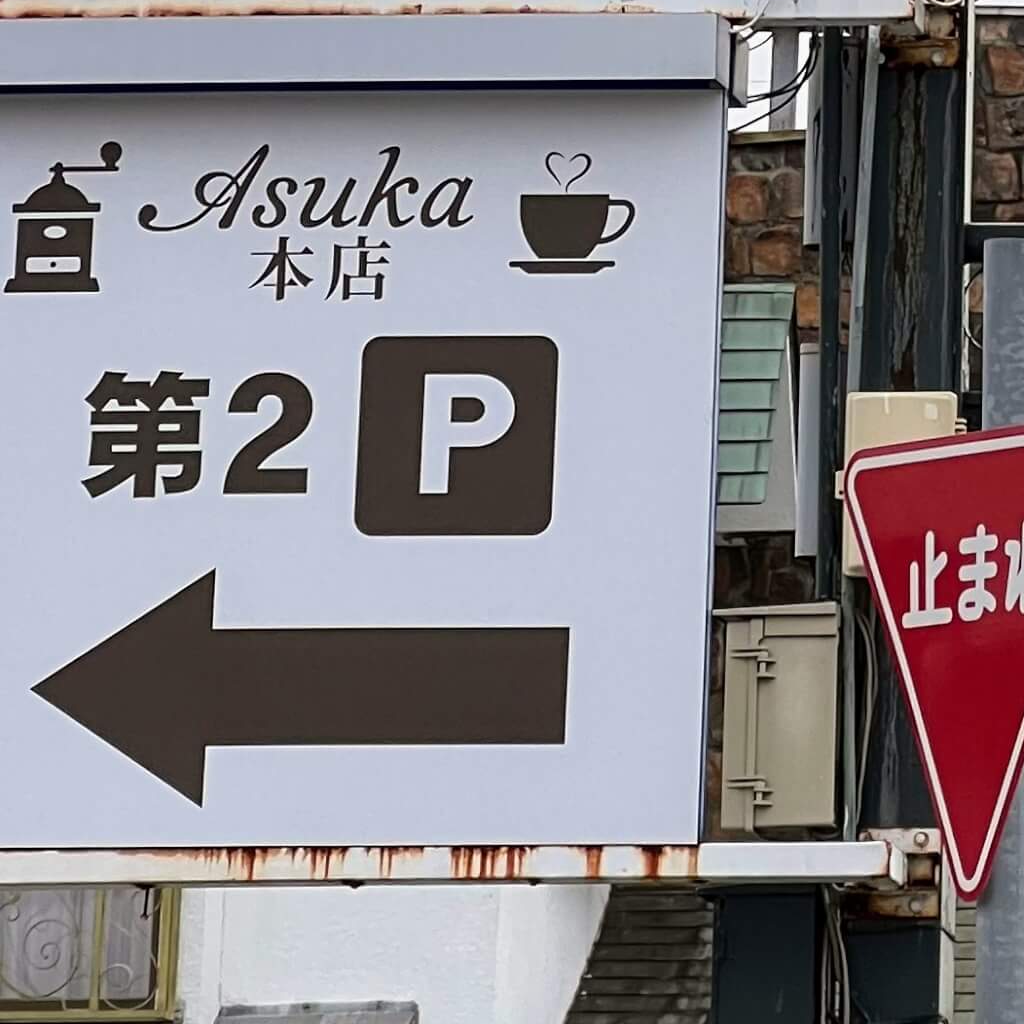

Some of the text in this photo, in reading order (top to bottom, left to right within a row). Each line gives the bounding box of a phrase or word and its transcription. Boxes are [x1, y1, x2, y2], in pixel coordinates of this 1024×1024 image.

[138, 143, 474, 232] Asuka
[248, 235, 392, 301] 本店
[81, 370, 314, 499] 第2
